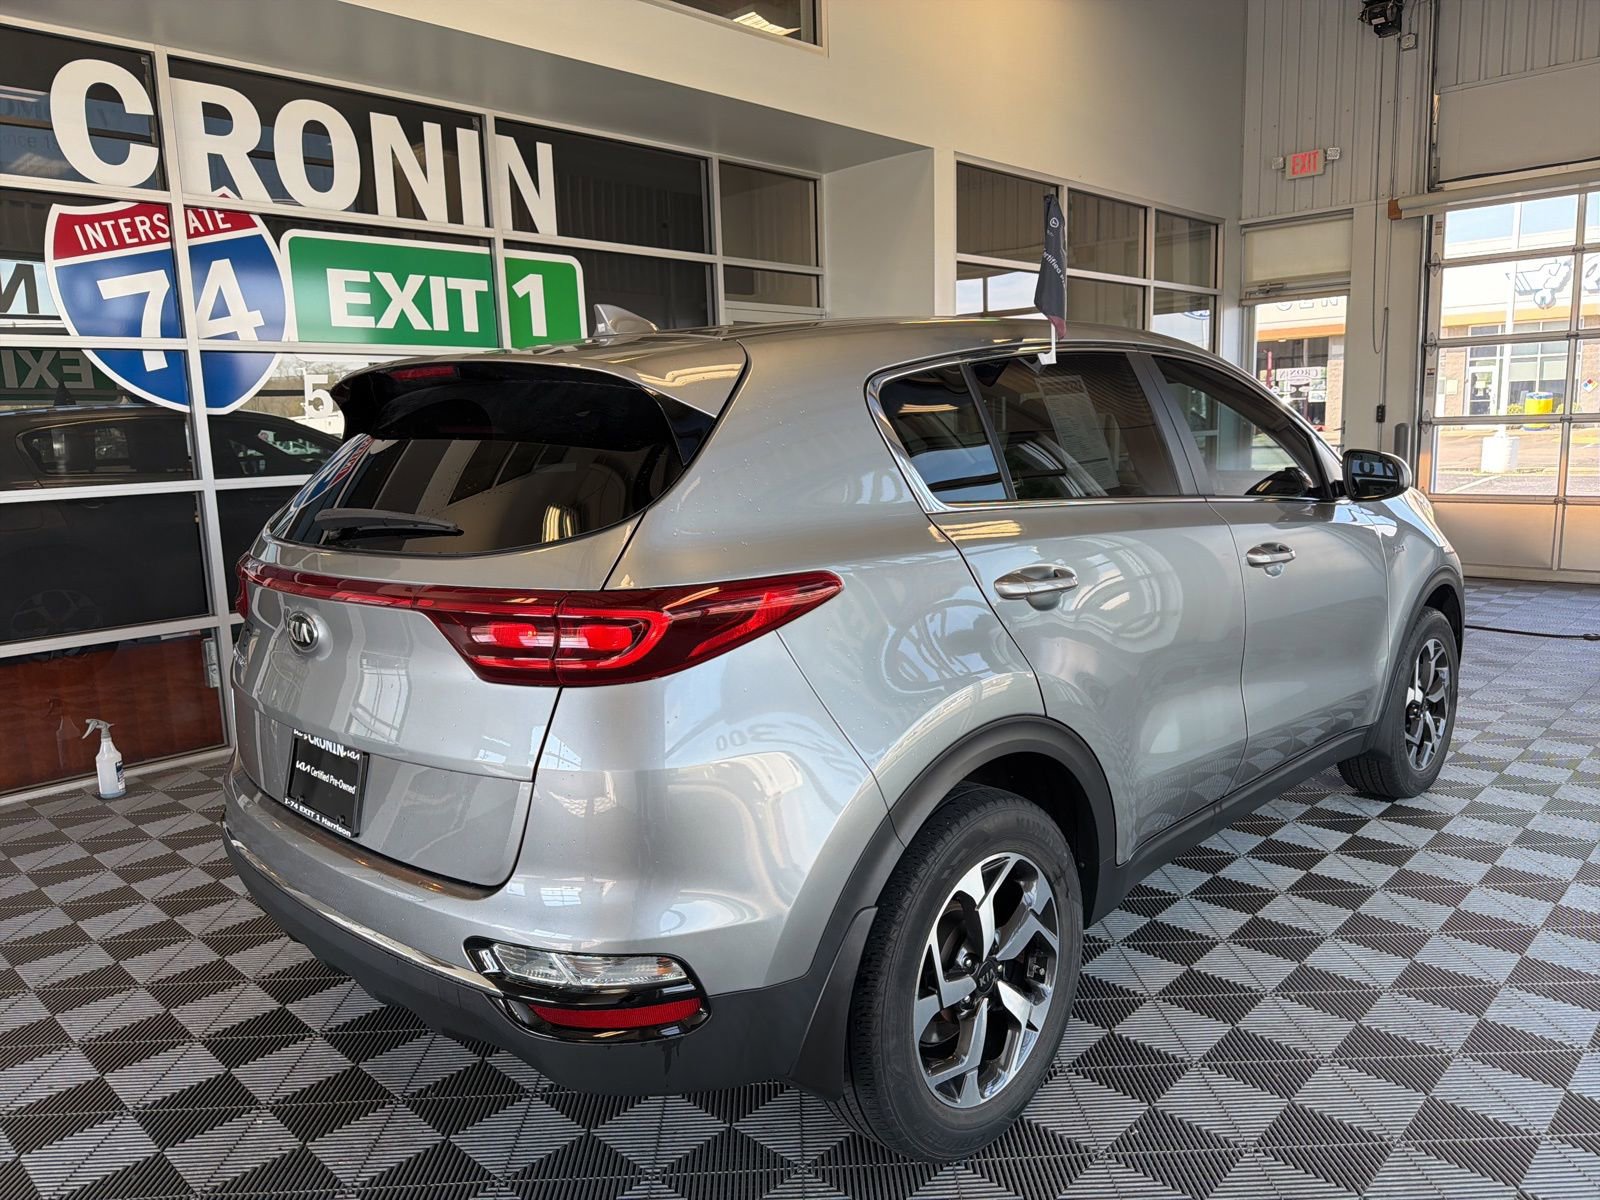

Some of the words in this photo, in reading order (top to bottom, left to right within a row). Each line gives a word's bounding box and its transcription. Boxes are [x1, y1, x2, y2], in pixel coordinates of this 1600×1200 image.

[50, 58, 558, 237] CRONIN
[1291, 150, 1319, 176] EXIT
[74, 208, 231, 251] INTERSATE
[97, 259, 264, 372] 74
[327, 268, 489, 332] EXIT
[512, 274, 548, 337] 1
[310, 766, 330, 783] Certified
[329, 774, 356, 795] Pre-Owned
[284, 797, 299, 810] I-74
[299, 804, 315, 818] EXIT
[316, 813, 321, 821] 1
[321, 816, 352, 838] Harrison
[978, 967, 995, 987] KIA
